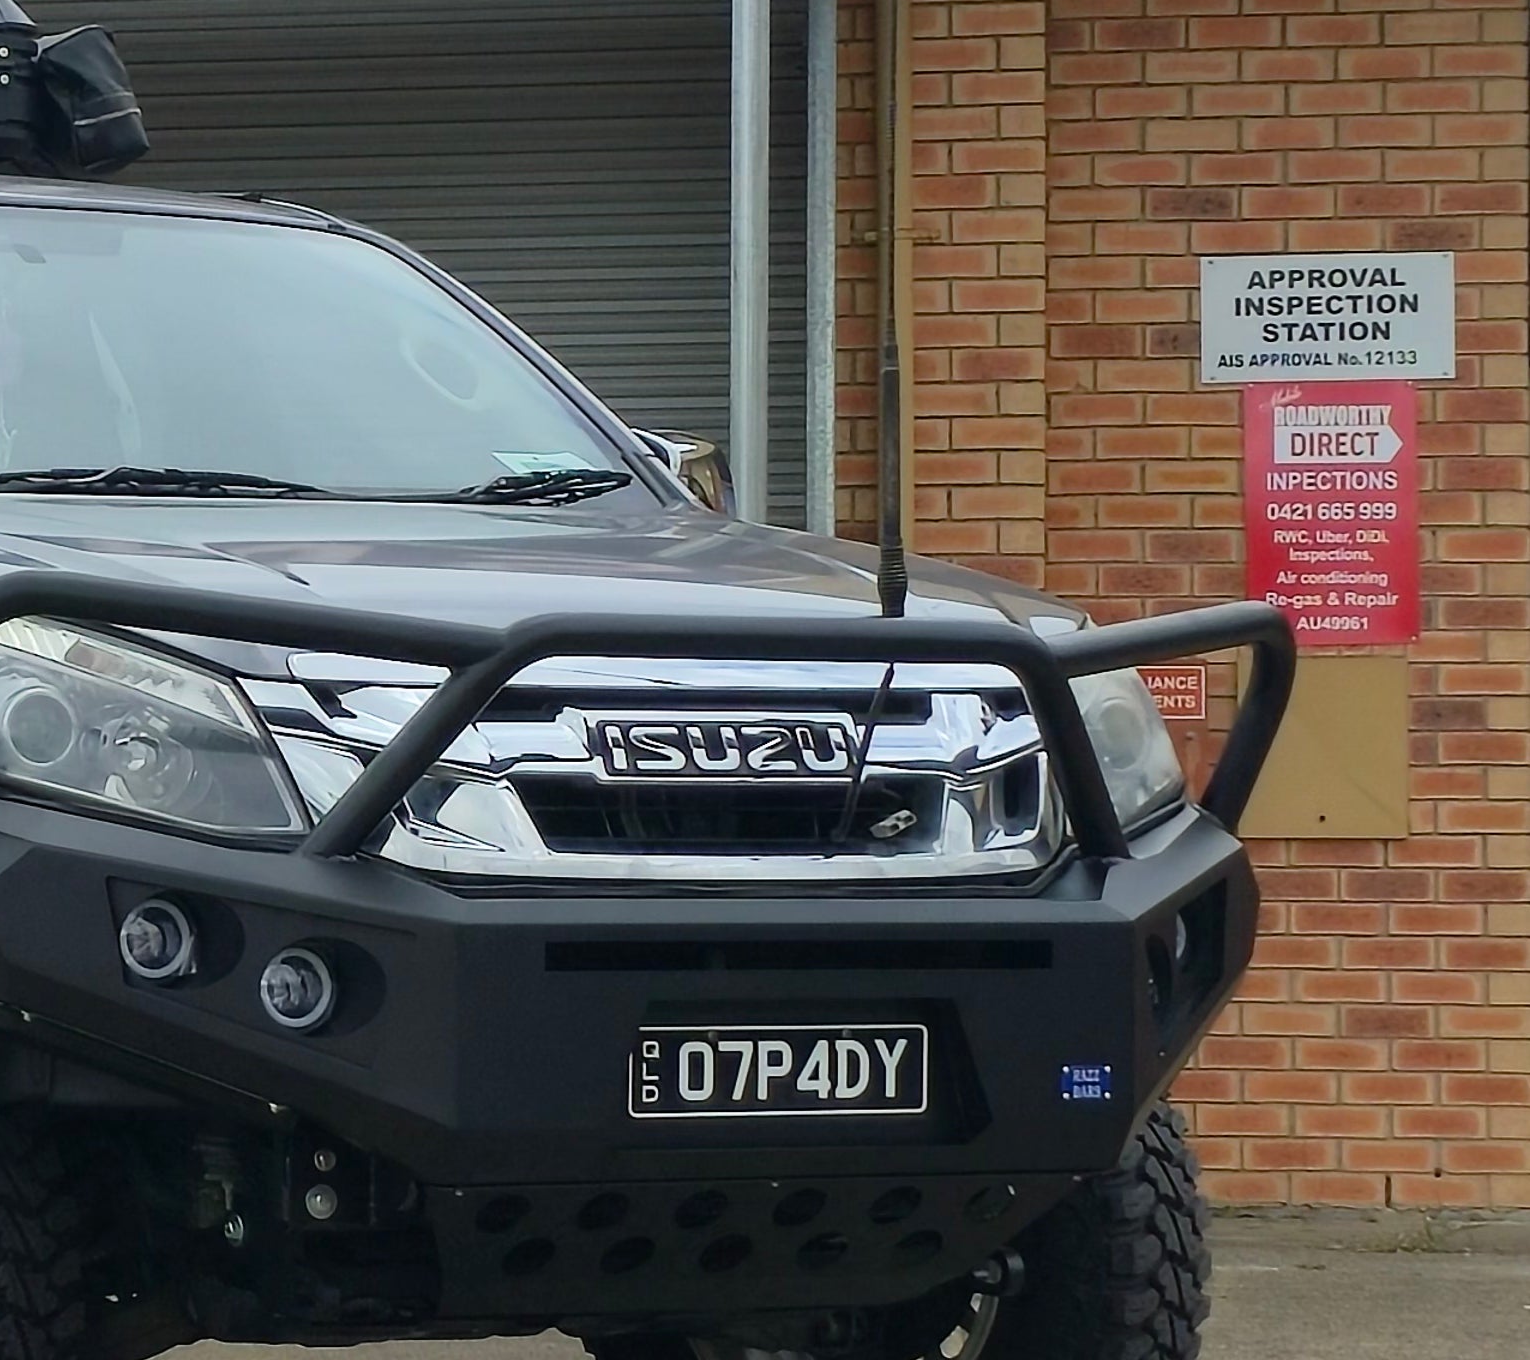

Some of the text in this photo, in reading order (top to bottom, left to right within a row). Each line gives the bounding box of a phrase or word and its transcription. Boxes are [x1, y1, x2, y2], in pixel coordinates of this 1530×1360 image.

[1247, 268, 1406, 289] APPROVAL
[1234, 293, 1419, 316] INSPECTION
[1262, 321, 1391, 342] STATION
[1218, 354, 1244, 368] AIS
[1249, 352, 1332, 367] APPROVAL
[1274, 405, 1392, 426] ROADWORTHY
[1291, 432, 1379, 456] DIRECT
[1266, 471, 1398, 491] INPECTIONS
[1267, 503, 1397, 520] 0421 665 999
[1274, 530, 1312, 544] RWC,
[1316, 530, 1352, 544] Uber,
[1276, 570, 1388, 587] Air conditioning
[1266, 592, 1399, 609] Re-gas & Repair
[604, 725, 849, 771] ISUZU
[641, 1041, 660, 1102] QLD
